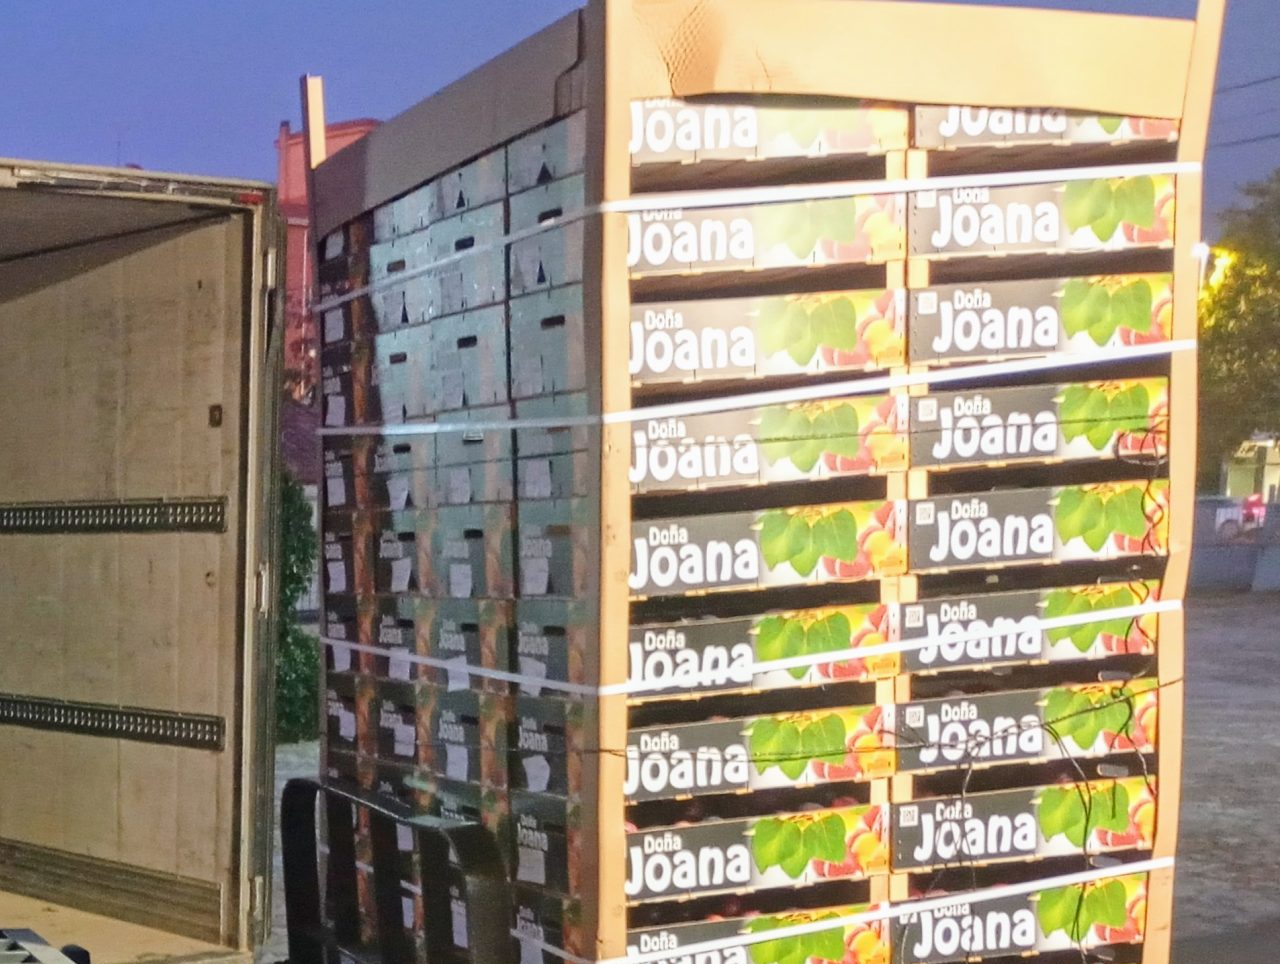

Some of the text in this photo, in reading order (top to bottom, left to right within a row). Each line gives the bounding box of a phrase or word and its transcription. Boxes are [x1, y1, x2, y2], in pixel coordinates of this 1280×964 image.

[629, 100, 756, 153] Joana
[627, 212, 754, 266] Joana
[931, 195, 1059, 248] Joana
[644, 309, 684, 330] Doña
[954, 289, 991, 310] Doña
[629, 321, 755, 374] Joana
[932, 301, 1058, 353] Joana
[648, 418, 686, 440] Doña
[954, 395, 991, 416] Doña
[629, 430, 759, 483] Joana
[932, 407, 1057, 459] Joana
[951, 499, 988, 520] Doña
[649, 524, 688, 546] Doña
[929, 511, 1053, 562] Joana
[628, 538, 759, 589] Joana
[940, 601, 977, 622] Doña
[644, 629, 685, 650] Doña
[919, 614, 1042, 663] Joana
[627, 642, 753, 690] Joana
[941, 702, 977, 723] Doña
[640, 731, 680, 751] Doña
[919, 714, 1043, 763] Joana
[623, 744, 749, 795] Joana
[644, 833, 682, 854] Doña
[914, 813, 1036, 861] Joana
[624, 844, 751, 895] Joana
[640, 931, 678, 952] Doña
[913, 909, 1036, 959] Joana
